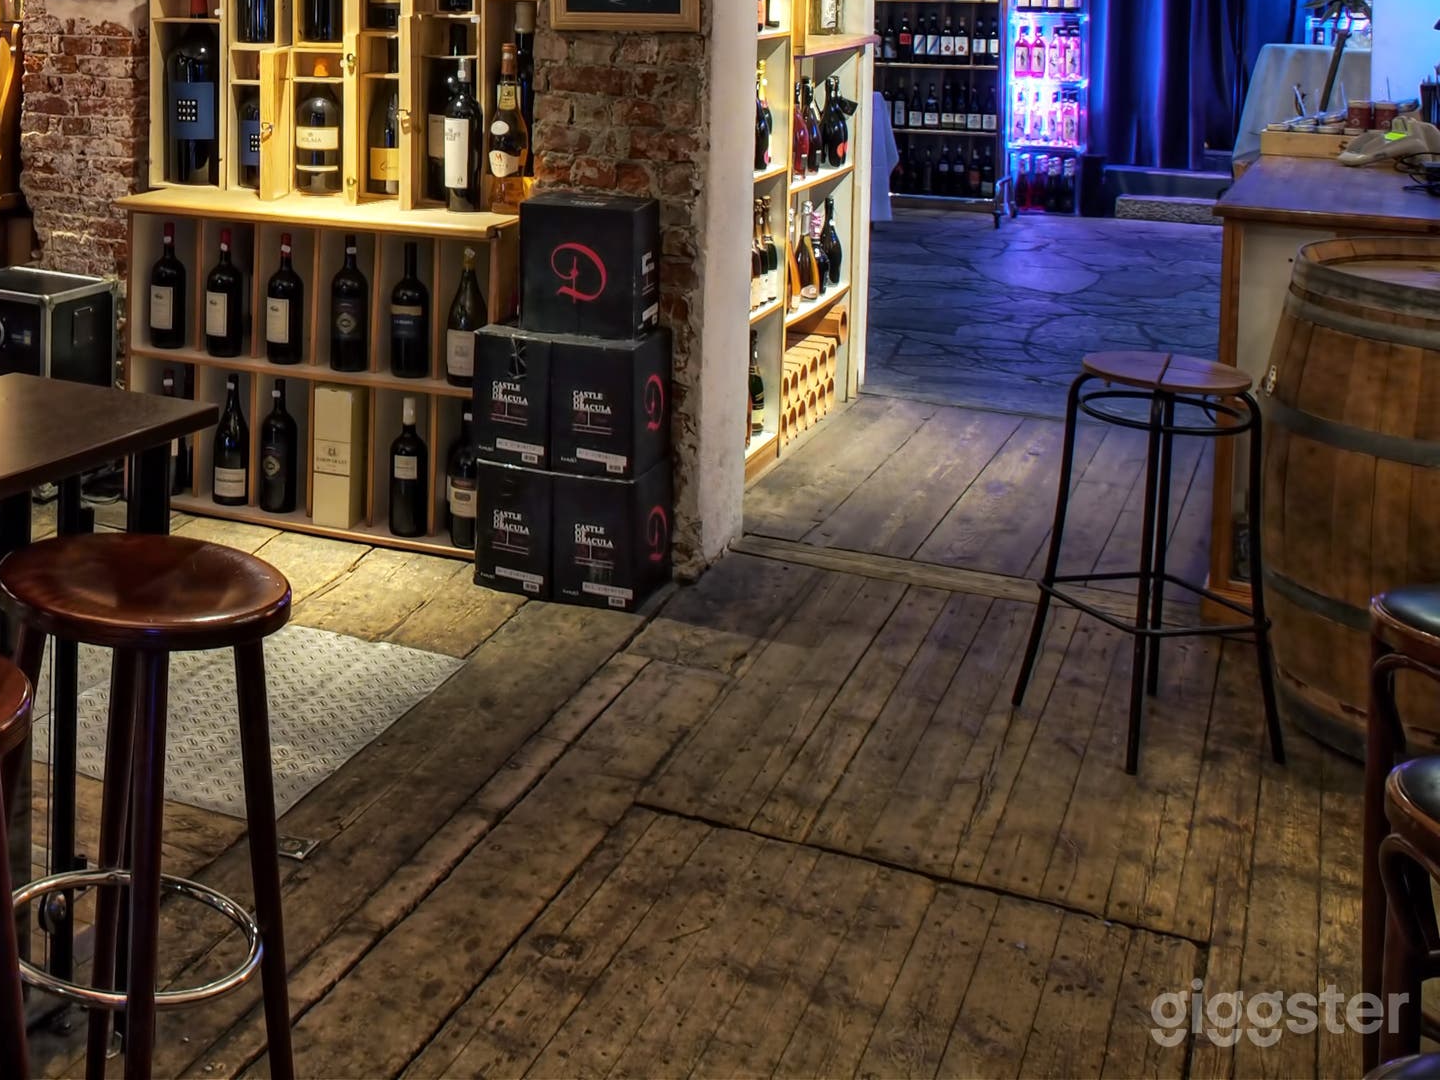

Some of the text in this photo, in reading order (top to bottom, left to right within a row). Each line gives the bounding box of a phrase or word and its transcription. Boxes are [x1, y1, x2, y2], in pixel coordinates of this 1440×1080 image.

[492, 380, 520, 391] CASTLE
[492, 392, 529, 406] DRACULA
[573, 390, 603, 400] CASTLE
[573, 402, 612, 415] DRACULA
[493, 509, 522, 520] CASTLE
[493, 521, 530, 535] DRACULA
[575, 523, 605, 534] CASTLE
[575, 536, 614, 549] DRACULA
